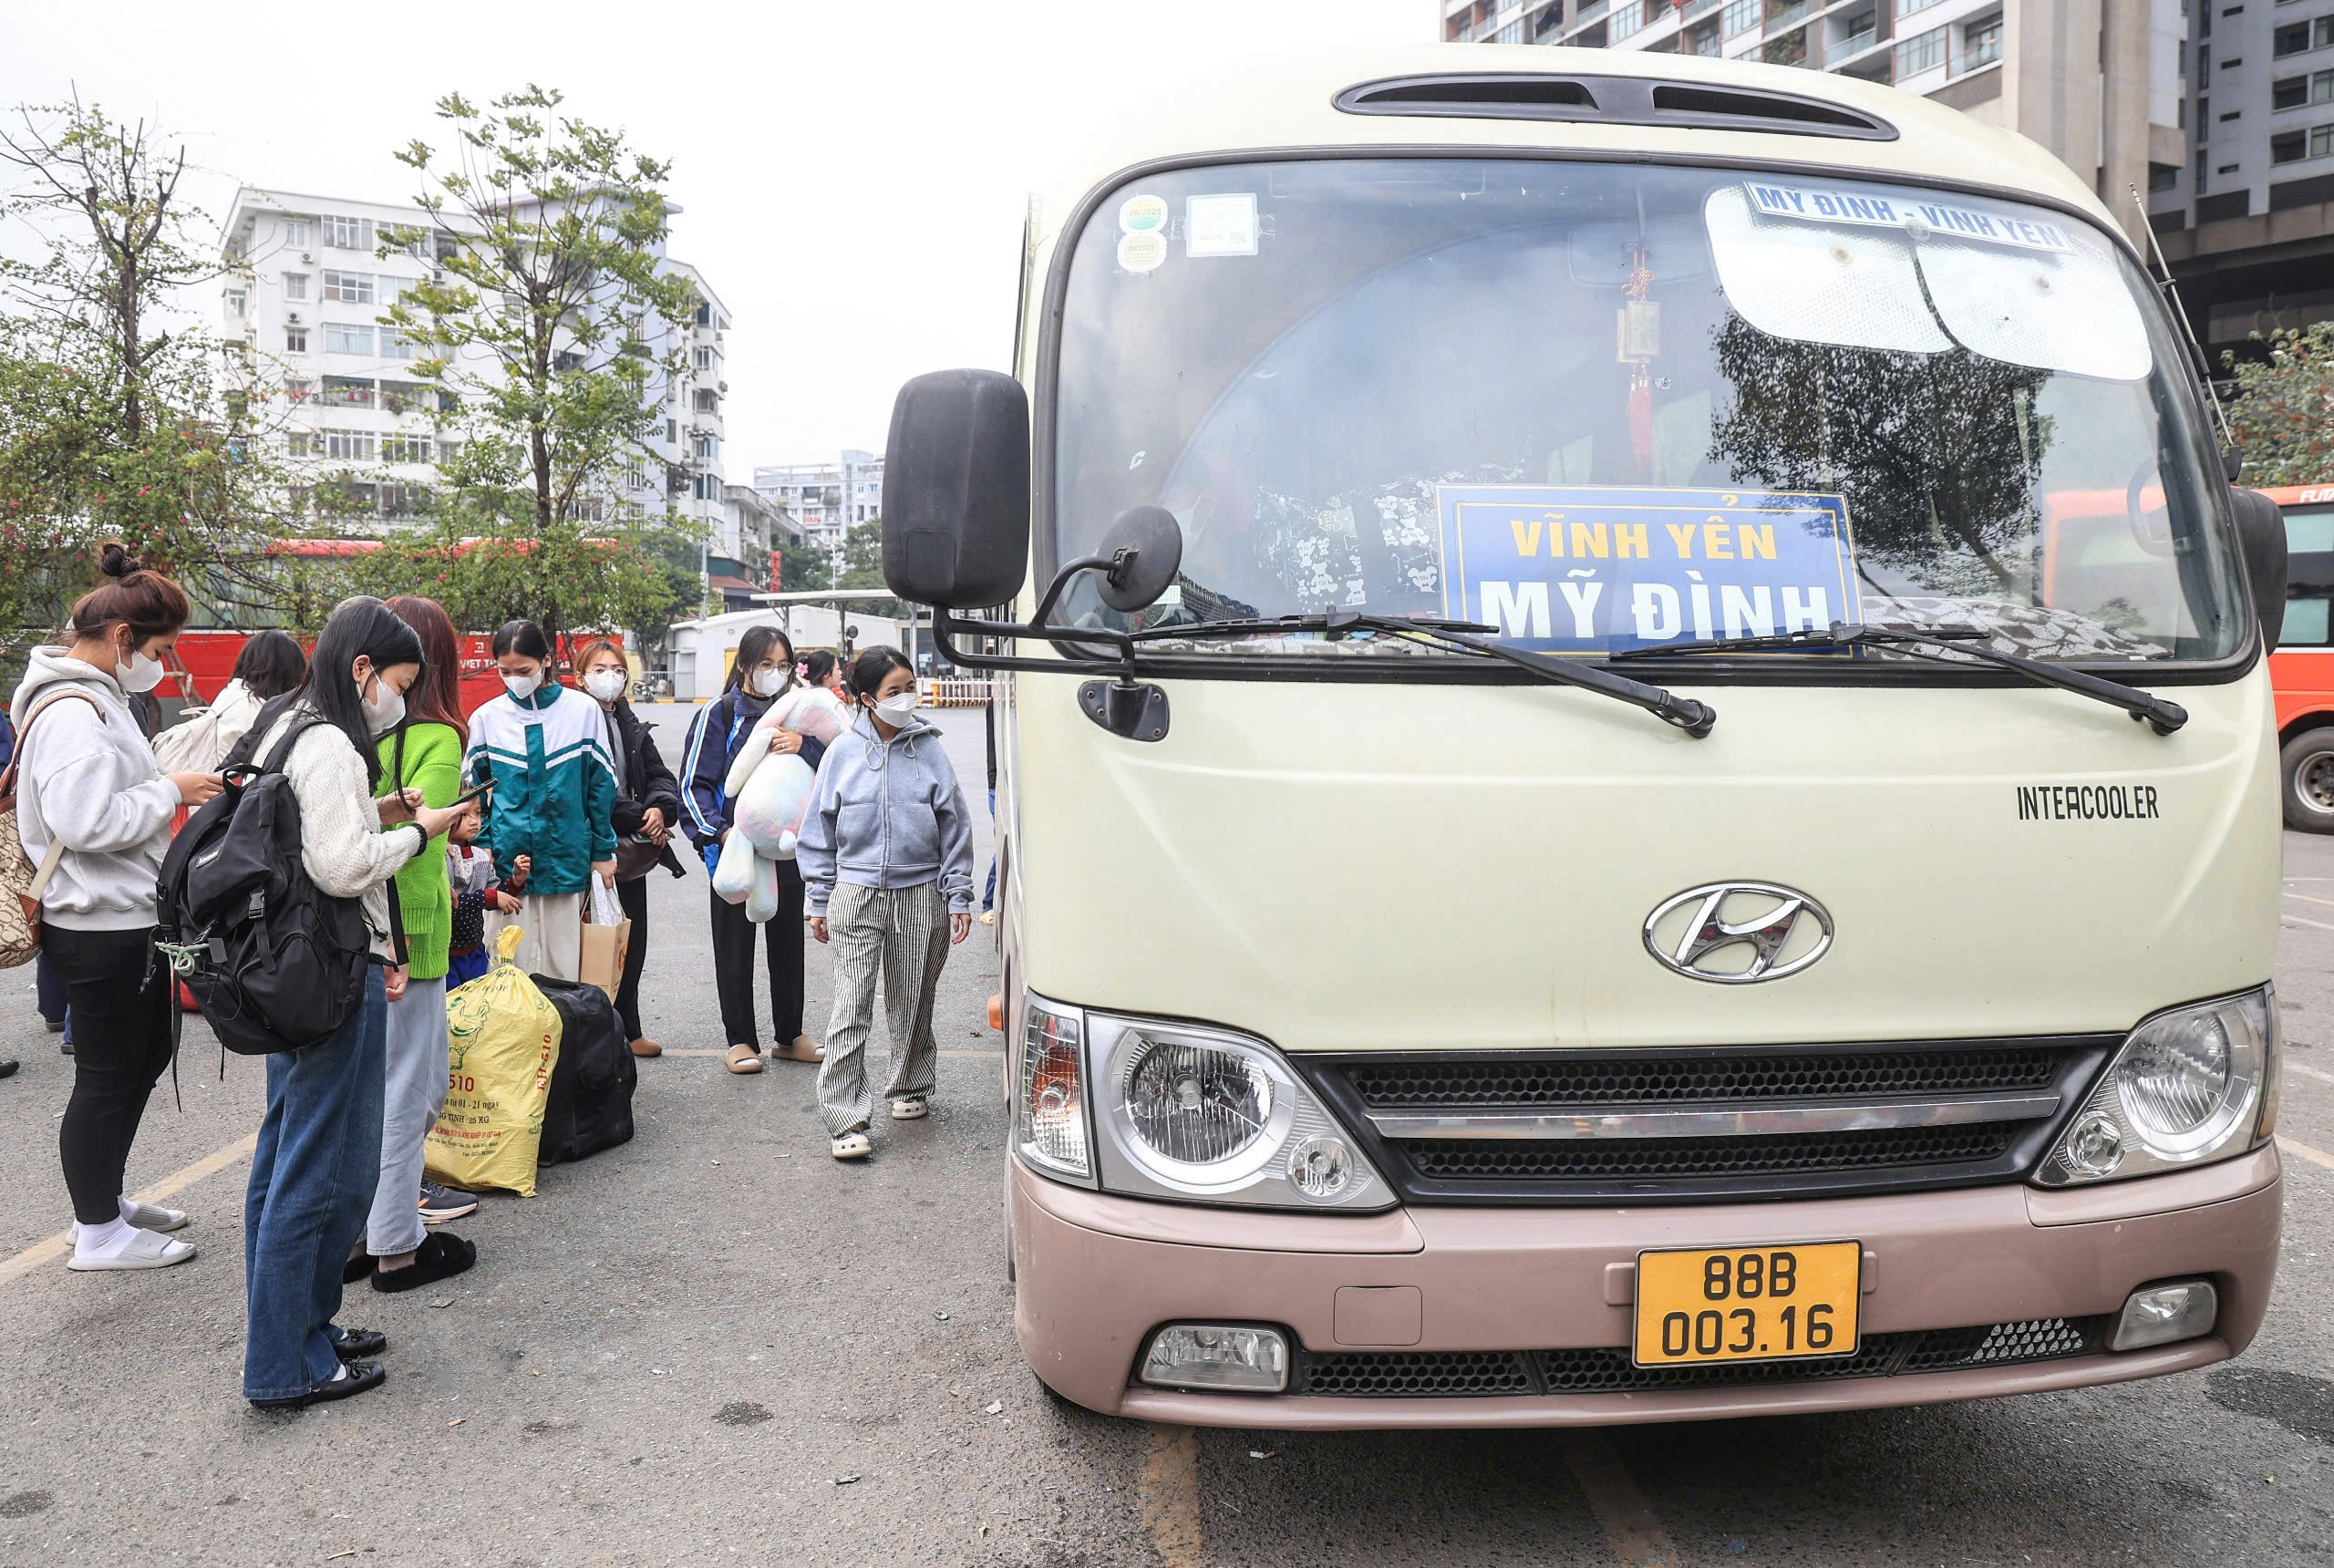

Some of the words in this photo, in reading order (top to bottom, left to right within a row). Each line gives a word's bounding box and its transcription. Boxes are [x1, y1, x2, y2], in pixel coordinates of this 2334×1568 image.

[1130, 207, 1161, 216] 06/2025
[1755, 187, 1805, 212] MỸ
[1812, 191, 1897, 221] ĐÌNH
[1918, 203, 1997, 236] VĨNH
[1998, 217, 2065, 248] YÊN
[1510, 512, 1649, 559] VĨNH
[1480, 569, 1604, 638] MỸ
[1630, 570, 1830, 641] ĐÌNH
[472, 1100, 480, 1109] 21
[478, 1116, 490, 1124] KG
[1703, 1252, 1797, 1301] 88B
[1662, 1304, 1834, 1357] 003.16
